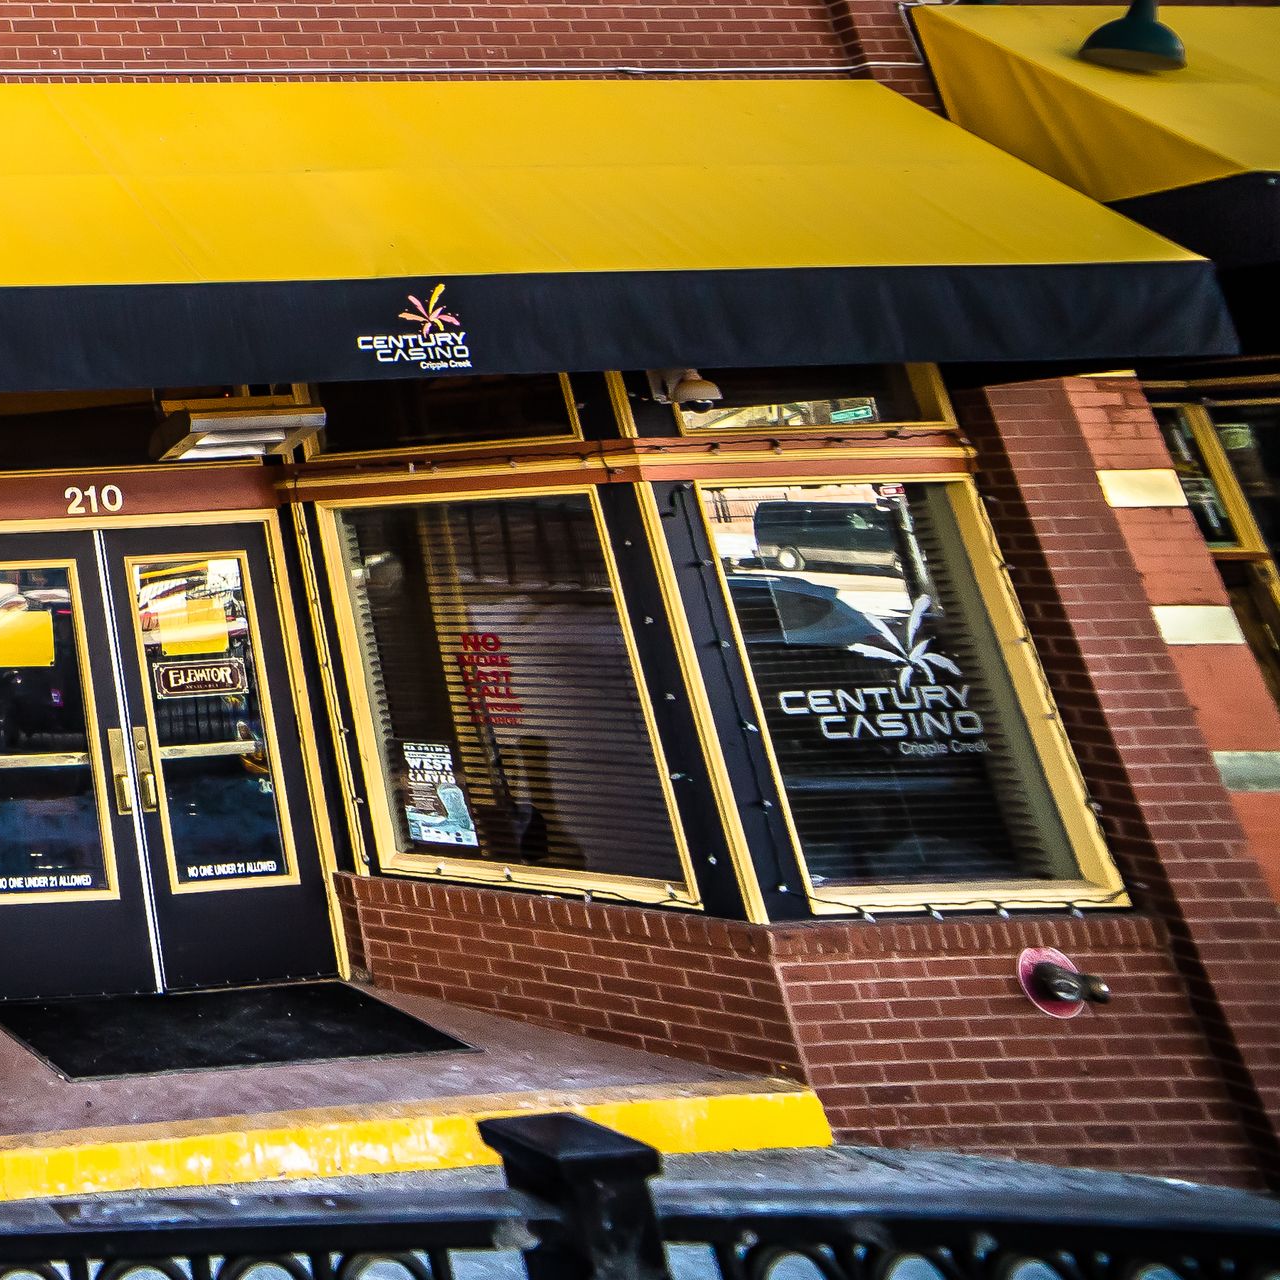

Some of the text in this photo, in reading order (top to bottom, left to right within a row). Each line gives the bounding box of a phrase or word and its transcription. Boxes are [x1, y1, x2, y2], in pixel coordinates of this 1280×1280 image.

[357, 331, 467, 350] CENTURY
[376, 345, 470, 362] CASINO
[420, 359, 473, 371] Cripple Creek
[64, 484, 123, 514] 210
[460, 632, 501, 652] NO
[168, 666, 234, 688] ELEVATOR
[778, 685, 970, 715] CENTURY
[820, 711, 984, 740] CASINO
[898, 738, 991, 757] Cripple Creek
[405, 758, 453, 771] WEST
[187, 860, 277, 878] NO ONE UNDER 21 ALLOWED
[8, 877, 24, 889] ONE
[25, 876, 49, 888] UNDER
[49, 876, 58, 887] 21
[59, 874, 92, 886] ALLOWED
